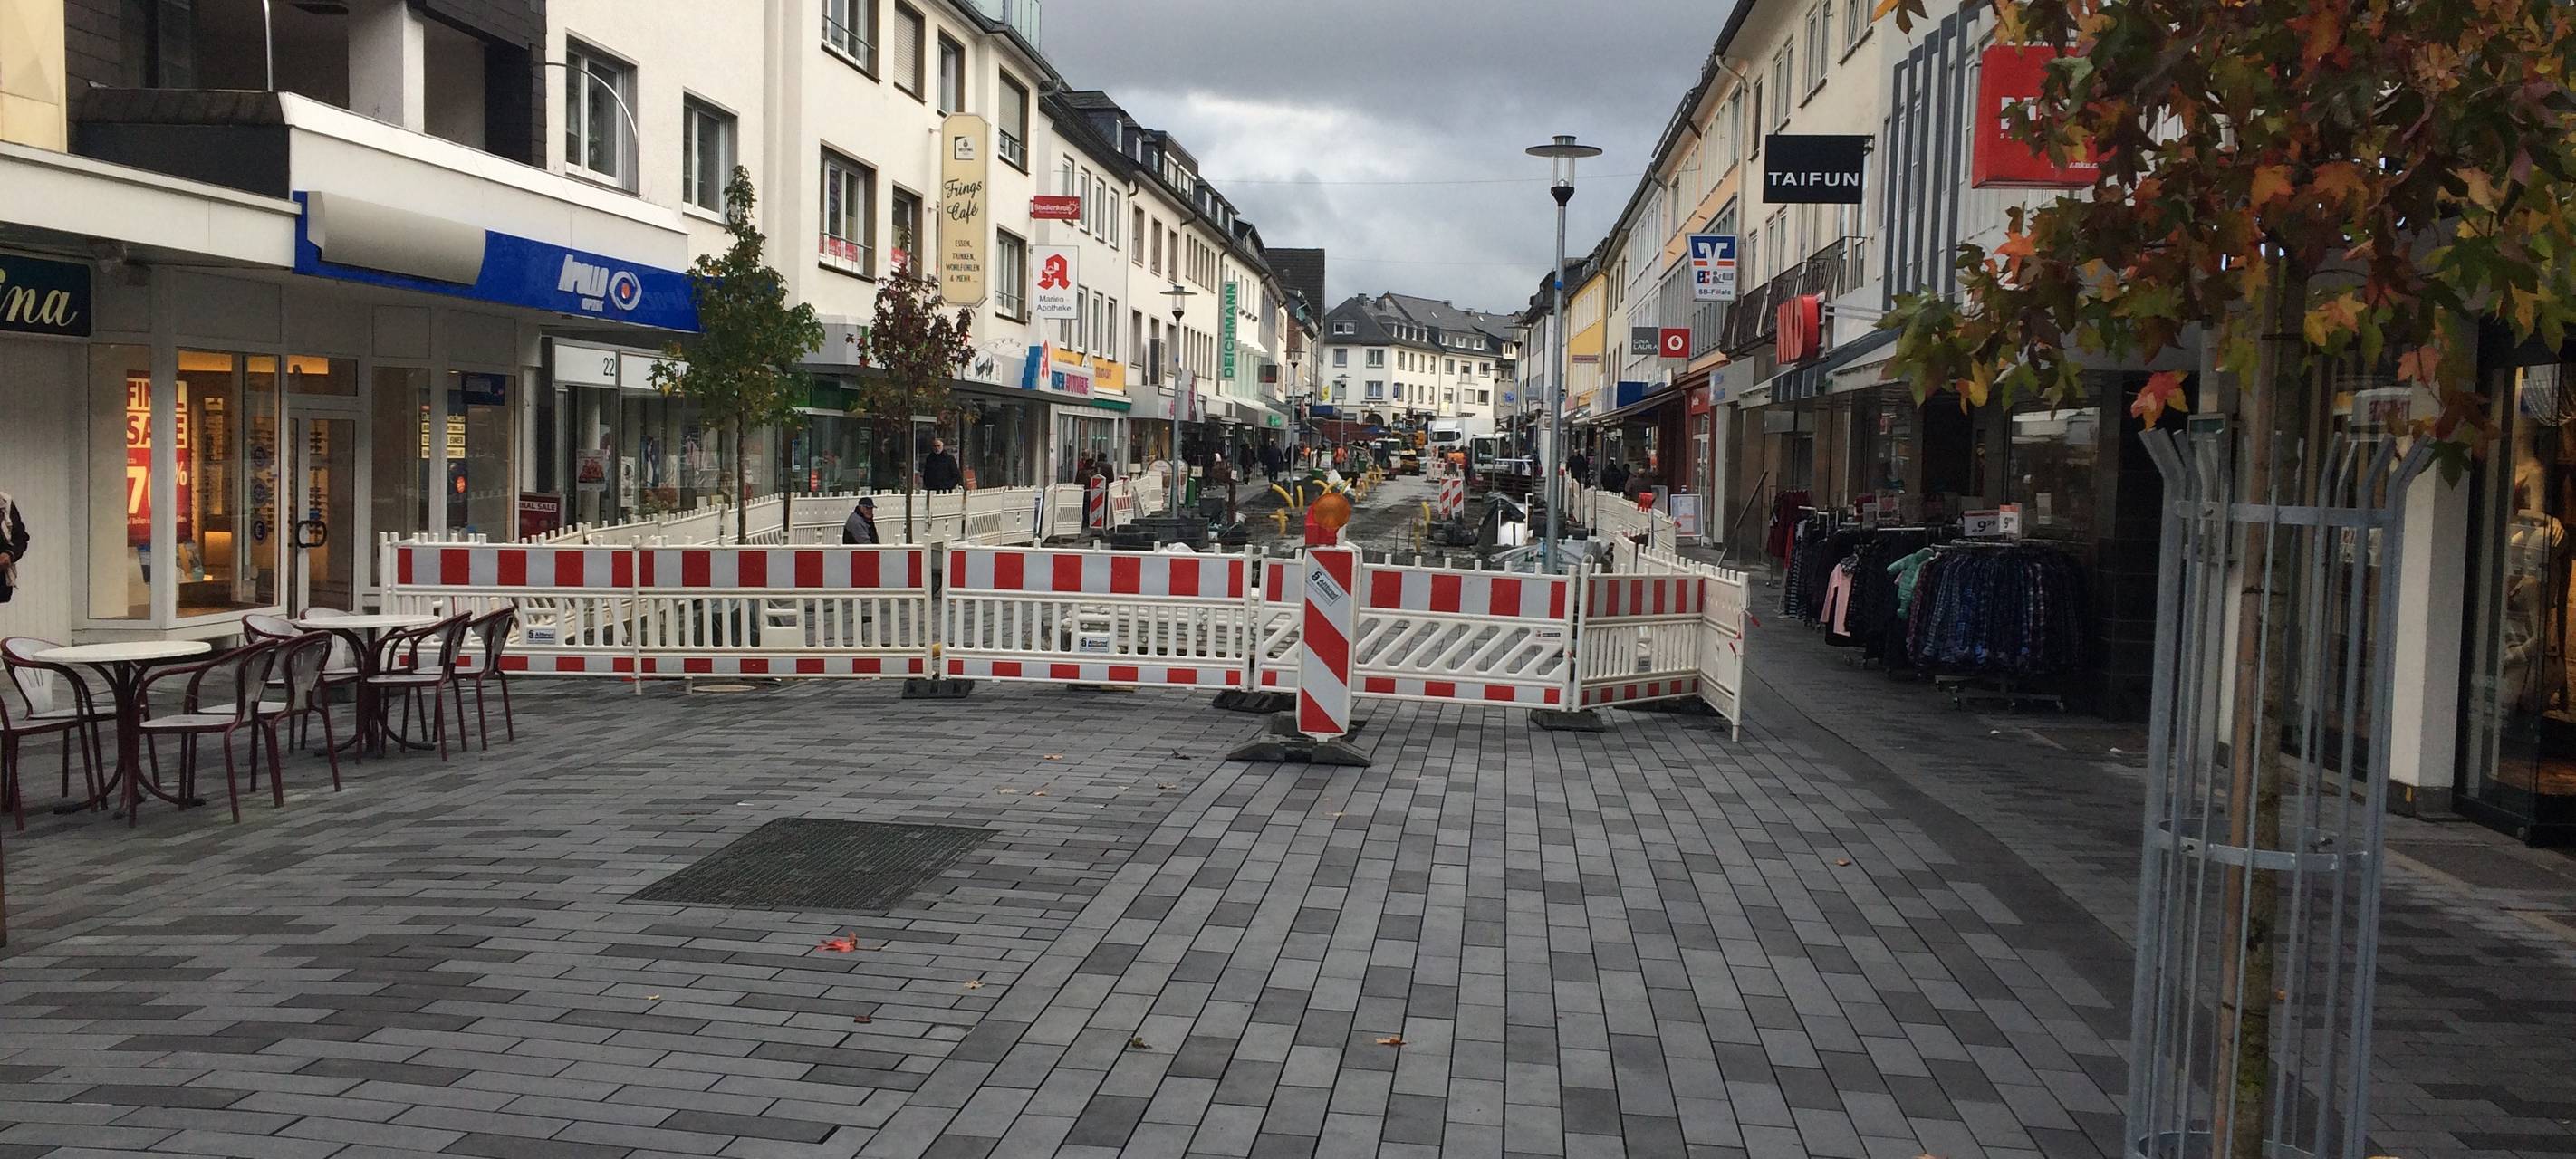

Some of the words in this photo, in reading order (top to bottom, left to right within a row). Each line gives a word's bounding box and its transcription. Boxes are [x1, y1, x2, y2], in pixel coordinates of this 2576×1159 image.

[944, 179, 983, 199] Frings
[1768, 172, 1859, 187] TAIFUN
[947, 200, 979, 224] Café
[1036, 304, 1072, 313] Apotheke
[1224, 283, 1236, 378] DEICHMANN
[602, 357, 615, 377] 22
